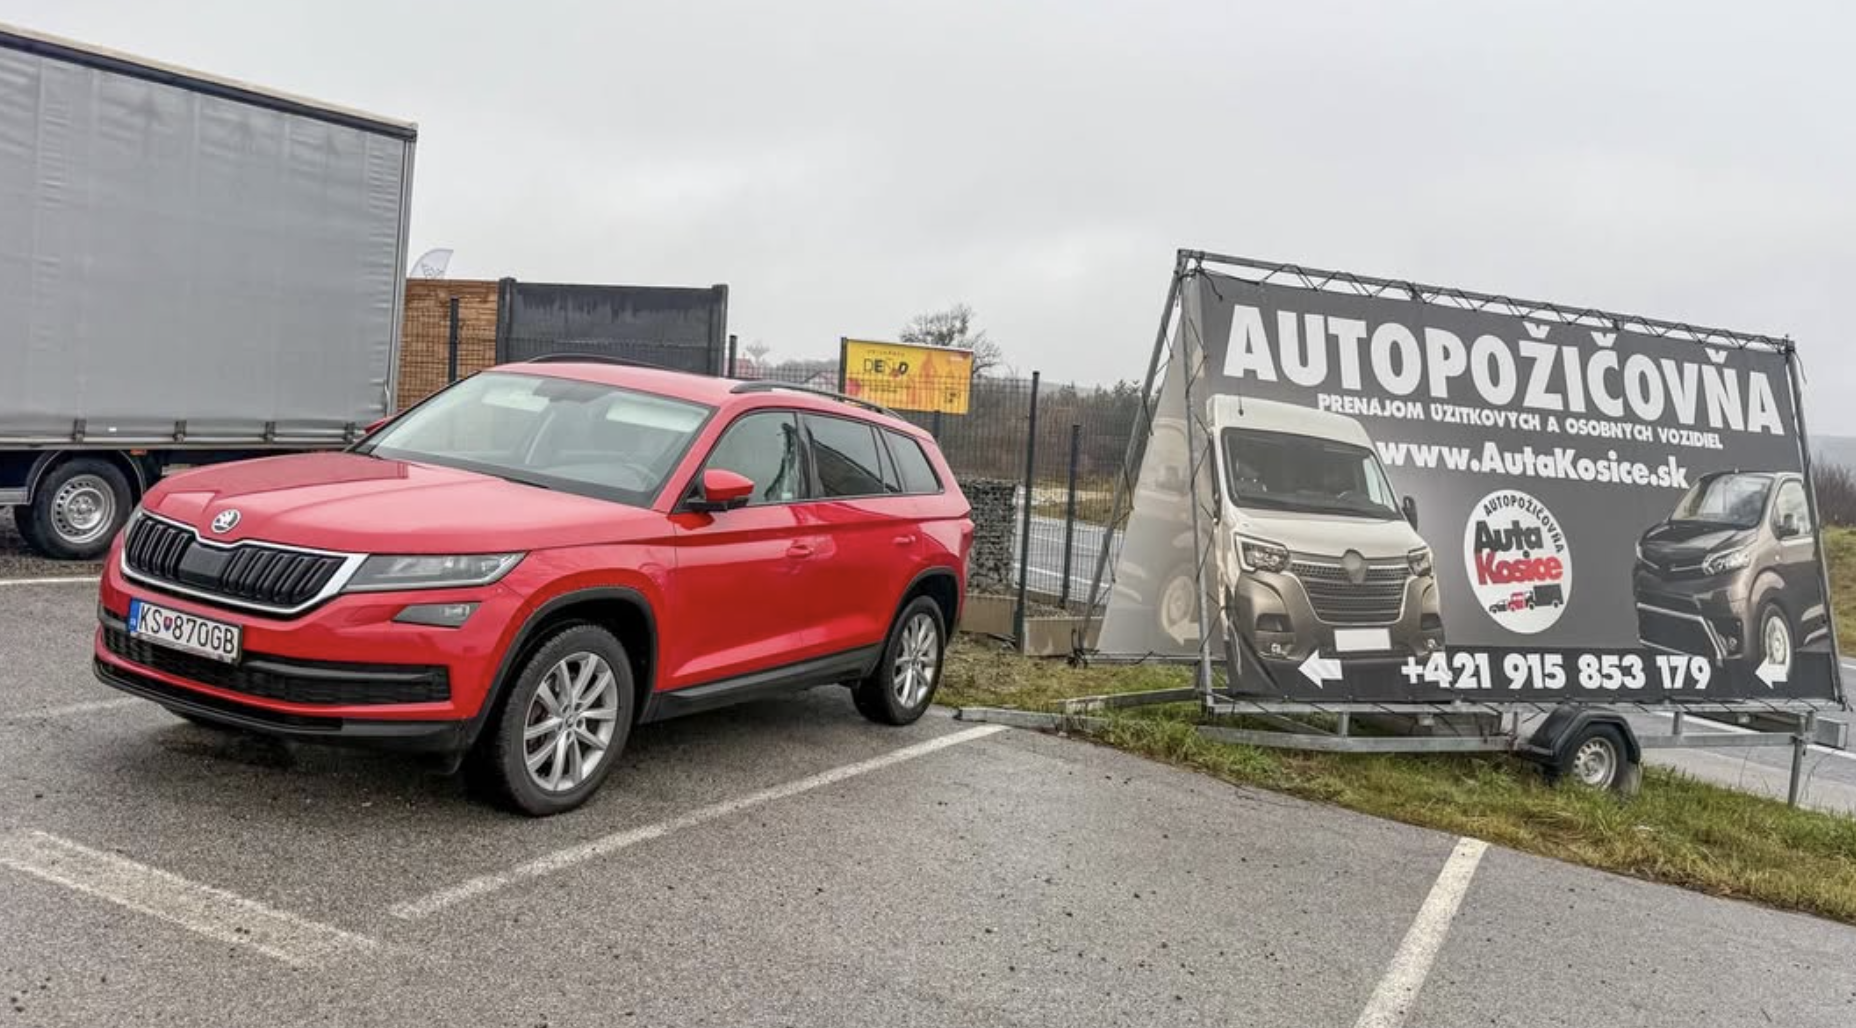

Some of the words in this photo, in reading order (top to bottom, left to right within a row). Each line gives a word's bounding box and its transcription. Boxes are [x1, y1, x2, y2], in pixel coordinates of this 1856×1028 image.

[1223, 305, 1785, 435] AUTOPOŽIČOVŇA
[1547, 416, 1560, 433] A
[1657, 427, 1724, 449] VOZIDIEL
[1376, 442, 1690, 489] www.AutaKosice.sk
[1474, 520, 1544, 553] Auta
[1475, 550, 1563, 585] Kosice
[1401, 652, 1492, 689] +421
[1503, 653, 1566, 690] 915
[1578, 654, 1646, 690] 853
[1656, 655, 1711, 690] 179
